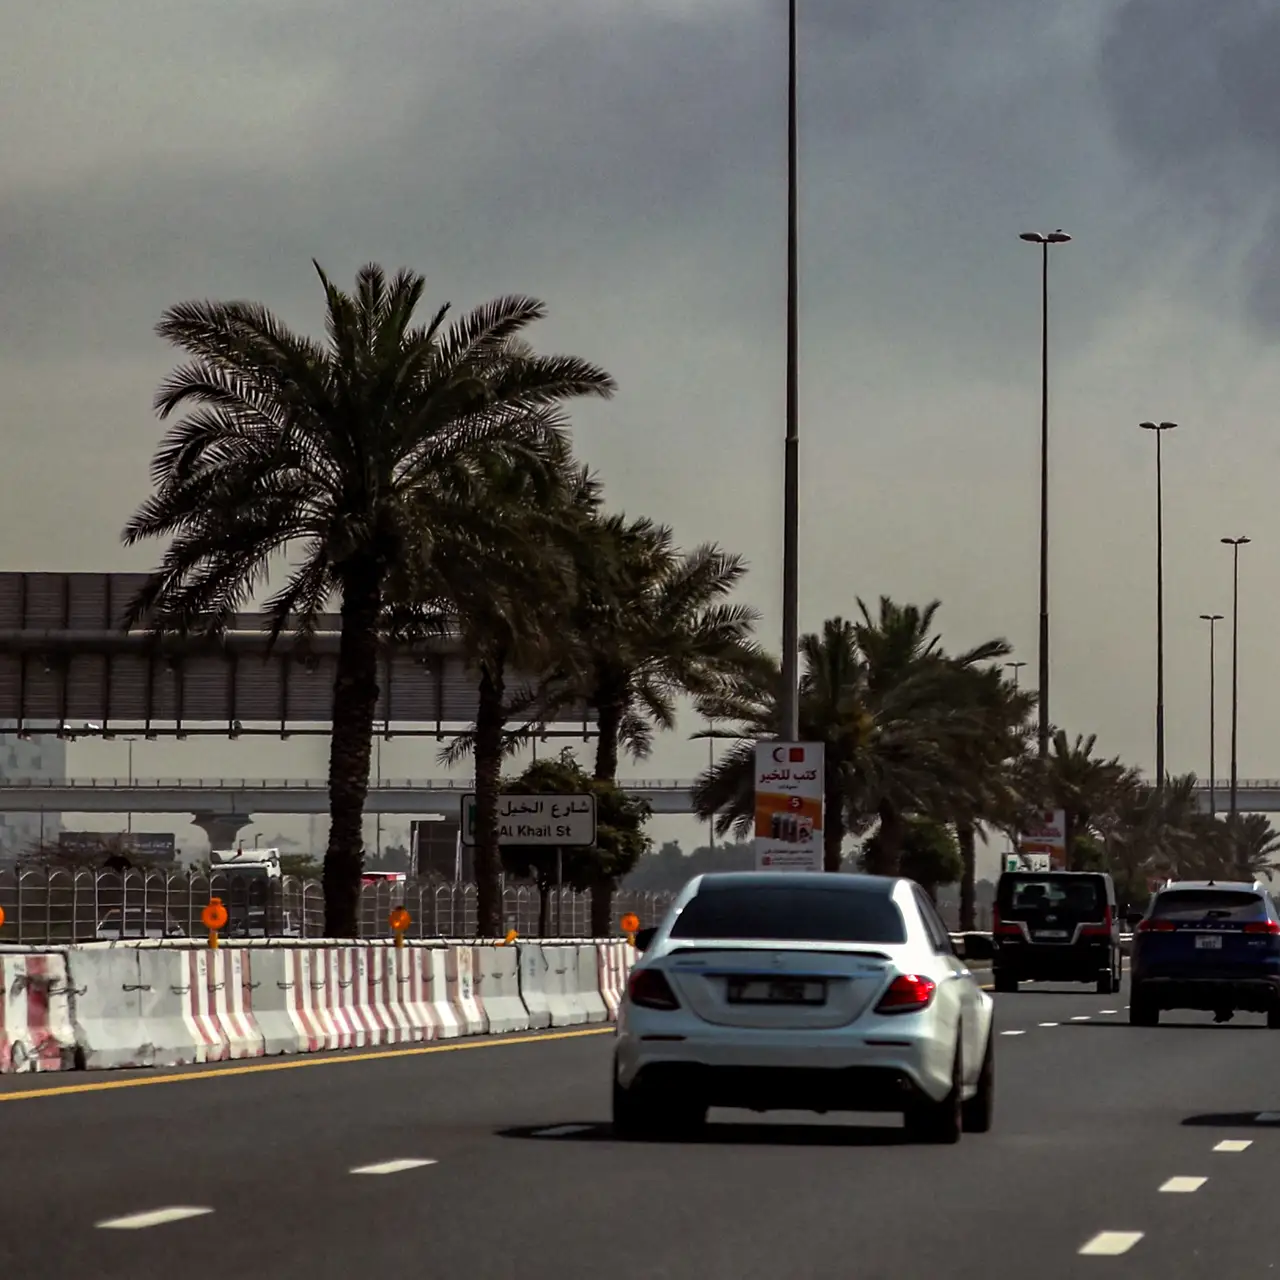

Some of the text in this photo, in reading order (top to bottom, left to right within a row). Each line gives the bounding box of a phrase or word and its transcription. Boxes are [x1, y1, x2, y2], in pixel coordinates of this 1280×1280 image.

[760, 769, 817, 783] كتب للخير
[501, 801, 589, 818] شارع الخيل
[500, 826, 572, 837] Al Khail St
